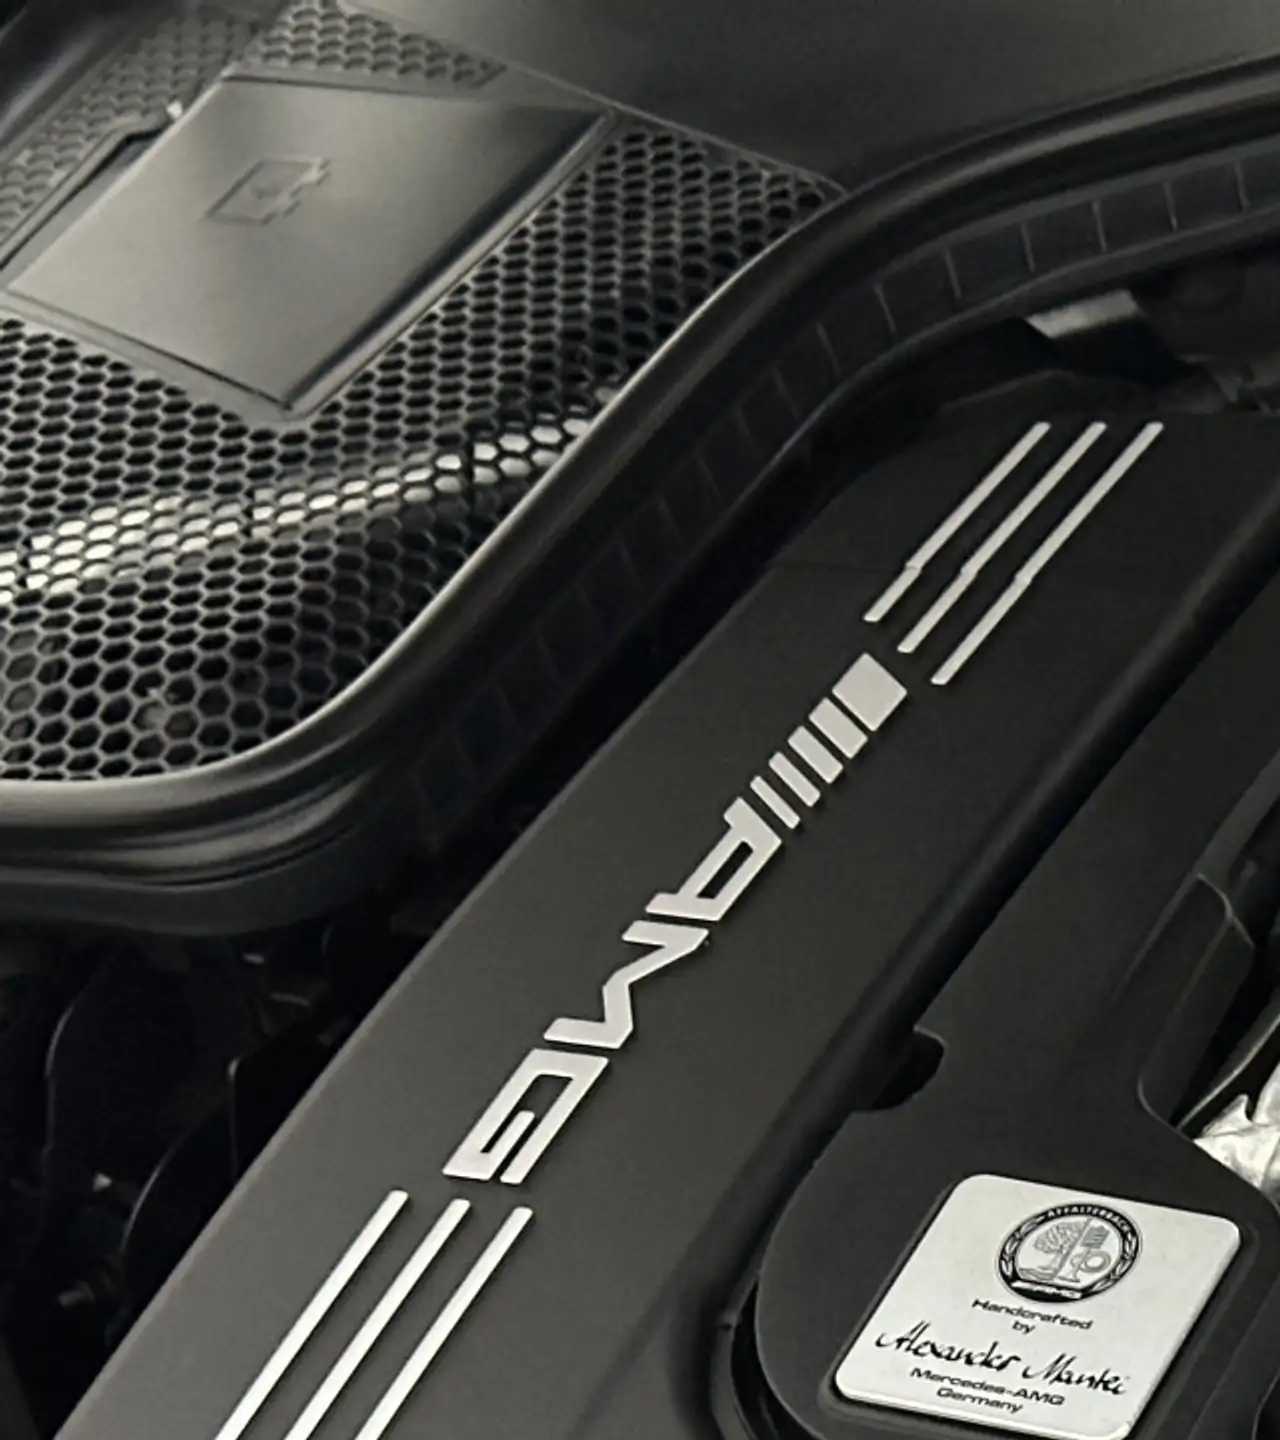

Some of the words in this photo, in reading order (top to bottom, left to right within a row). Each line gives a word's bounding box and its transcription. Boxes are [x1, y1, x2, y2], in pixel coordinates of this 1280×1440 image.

[442, 797, 782, 1185] AMG
[972, 1298, 1093, 1330] Handcrafted
[1011, 1319, 1036, 1334] by
[910, 1367, 1066, 1406] Mercedes-AMG
[936, 1387, 1024, 1415] Germany
